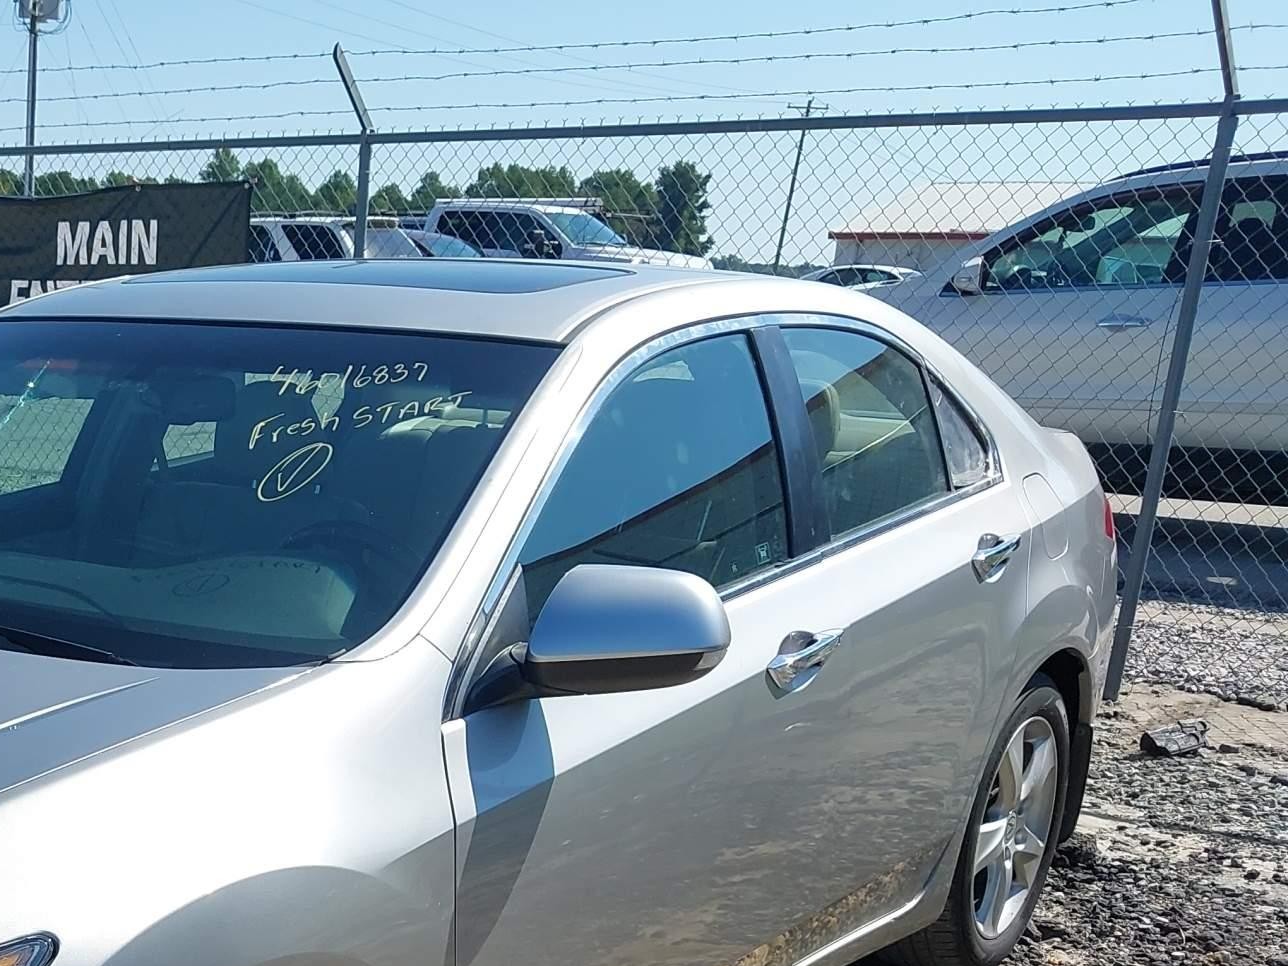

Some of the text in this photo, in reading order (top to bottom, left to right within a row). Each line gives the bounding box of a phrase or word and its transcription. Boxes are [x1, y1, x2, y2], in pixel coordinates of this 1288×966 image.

[56, 219, 158, 265] MAIN
[270, 361, 429, 397] 46016837
[248, 390, 473, 450] Fresh START
